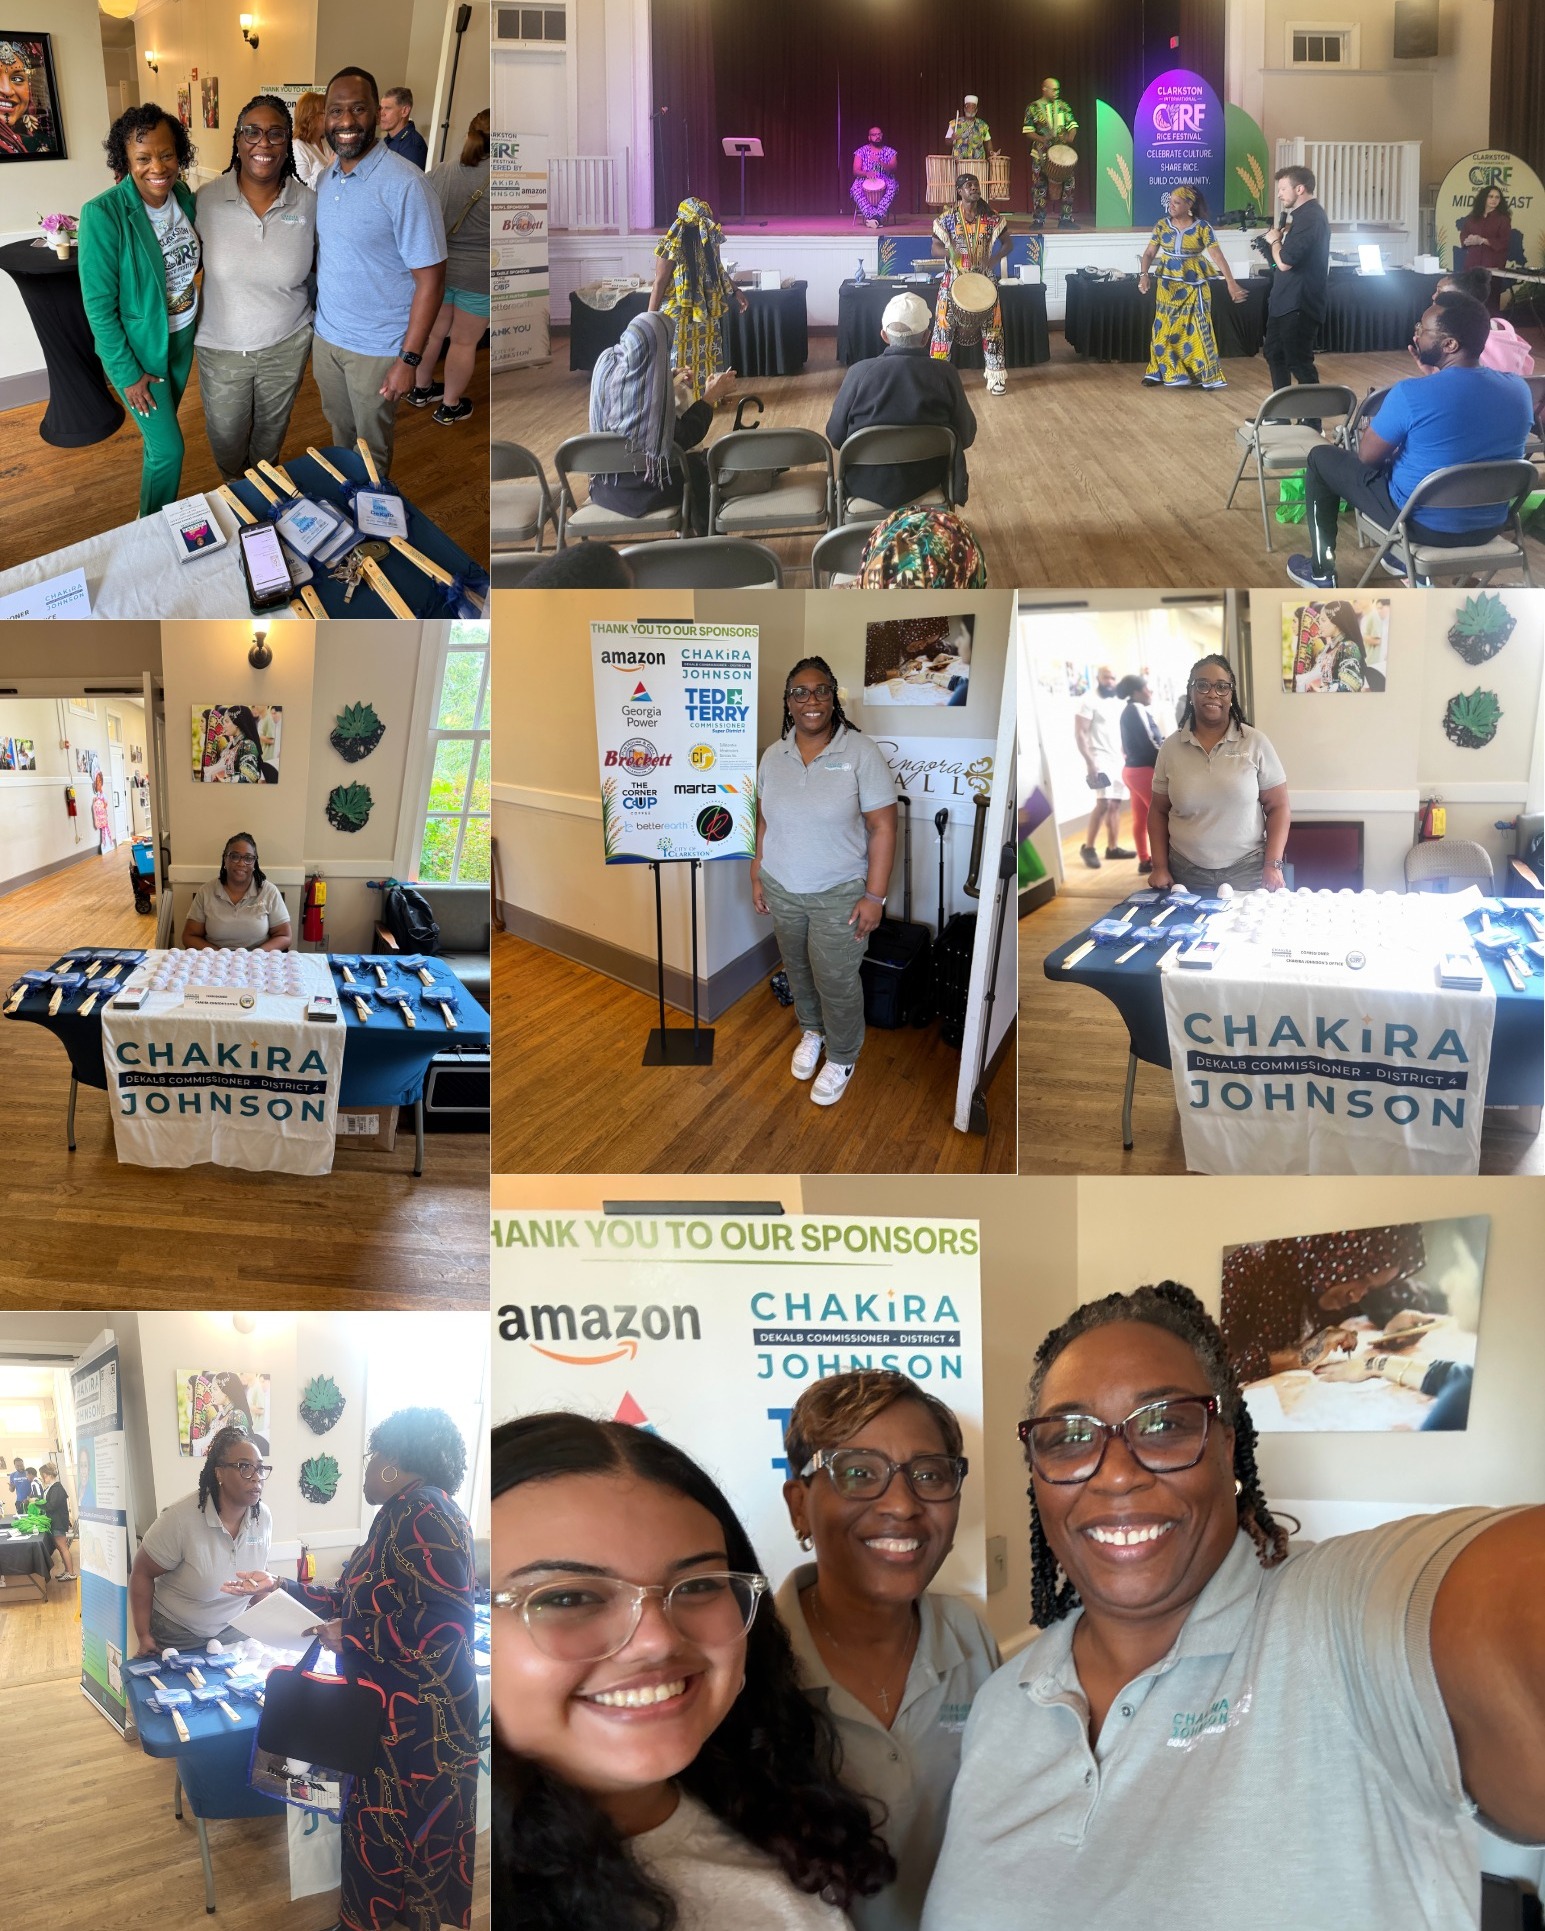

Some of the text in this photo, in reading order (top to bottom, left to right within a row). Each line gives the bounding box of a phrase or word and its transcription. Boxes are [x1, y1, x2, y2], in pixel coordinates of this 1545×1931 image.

[1157, 86, 1203, 96] CLARKSTON
[491, 131, 518, 139] RKSTON
[1156, 132, 1202, 141] RICE FESTIVAL
[1146, 149, 1214, 158] CELEBRATE CULTURE.
[1160, 163, 1182, 172] SHARE
[1149, 176, 1211, 186] BUILD COMMUNITY.
[521, 187, 547, 195] amazon
[1452, 195, 1476, 207] MID
[159, 227, 189, 248] CLARKSTON
[491, 300, 534, 312] etterearth
[491, 324, 531, 338] ANK YOU
[47, 592, 85, 611] JOHNSON
[591, 623, 759, 638] THANK YOU TO OUR SPONSORS
[601, 650, 666, 665] amazon
[682, 669, 752, 680] JOHNSON
[684, 688, 726, 705] TED
[621, 705, 662, 719] Georgia
[685, 705, 750, 722] TERRY
[627, 717, 658, 728] Power
[604, 750, 673, 767] Brockett
[673, 784, 717, 795] marta
[894, 771, 965, 796] ALL
[622, 796, 658, 810] CUP
[636, 821, 688, 831] betterearth
[668, 850, 710, 858] CLARKSTON
[1196, 1056, 1247, 1070] DEKALB
[1250, 1060, 1362, 1078] COMMISSIONER
[1376, 1068, 1444, 1086] DISTRICT
[1448, 1077, 1458, 1086] 4
[125, 1075, 166, 1085] DEKALB
[168, 1075, 250, 1087] COMMISSIONER
[261, 1079, 310, 1092] DISTRICT
[120, 1091, 326, 1123] JOHNSON
[1189, 1079, 1465, 1129] JOHNSON
[584, 1219, 659, 1249] YOU
[665, 1221, 713, 1250] TO
[720, 1222, 795, 1251] OUR
[801, 1223, 979, 1256] SPONSORS
[497, 1303, 702, 1342] amazon
[759, 1333, 804, 1343] DEKALB
[806, 1333, 891, 1344] COMMISSIONER
[899, 1334, 946, 1344] DISTRICT
[948, 1335, 956, 1344] 4
[756, 1353, 963, 1380] JOHNSON
